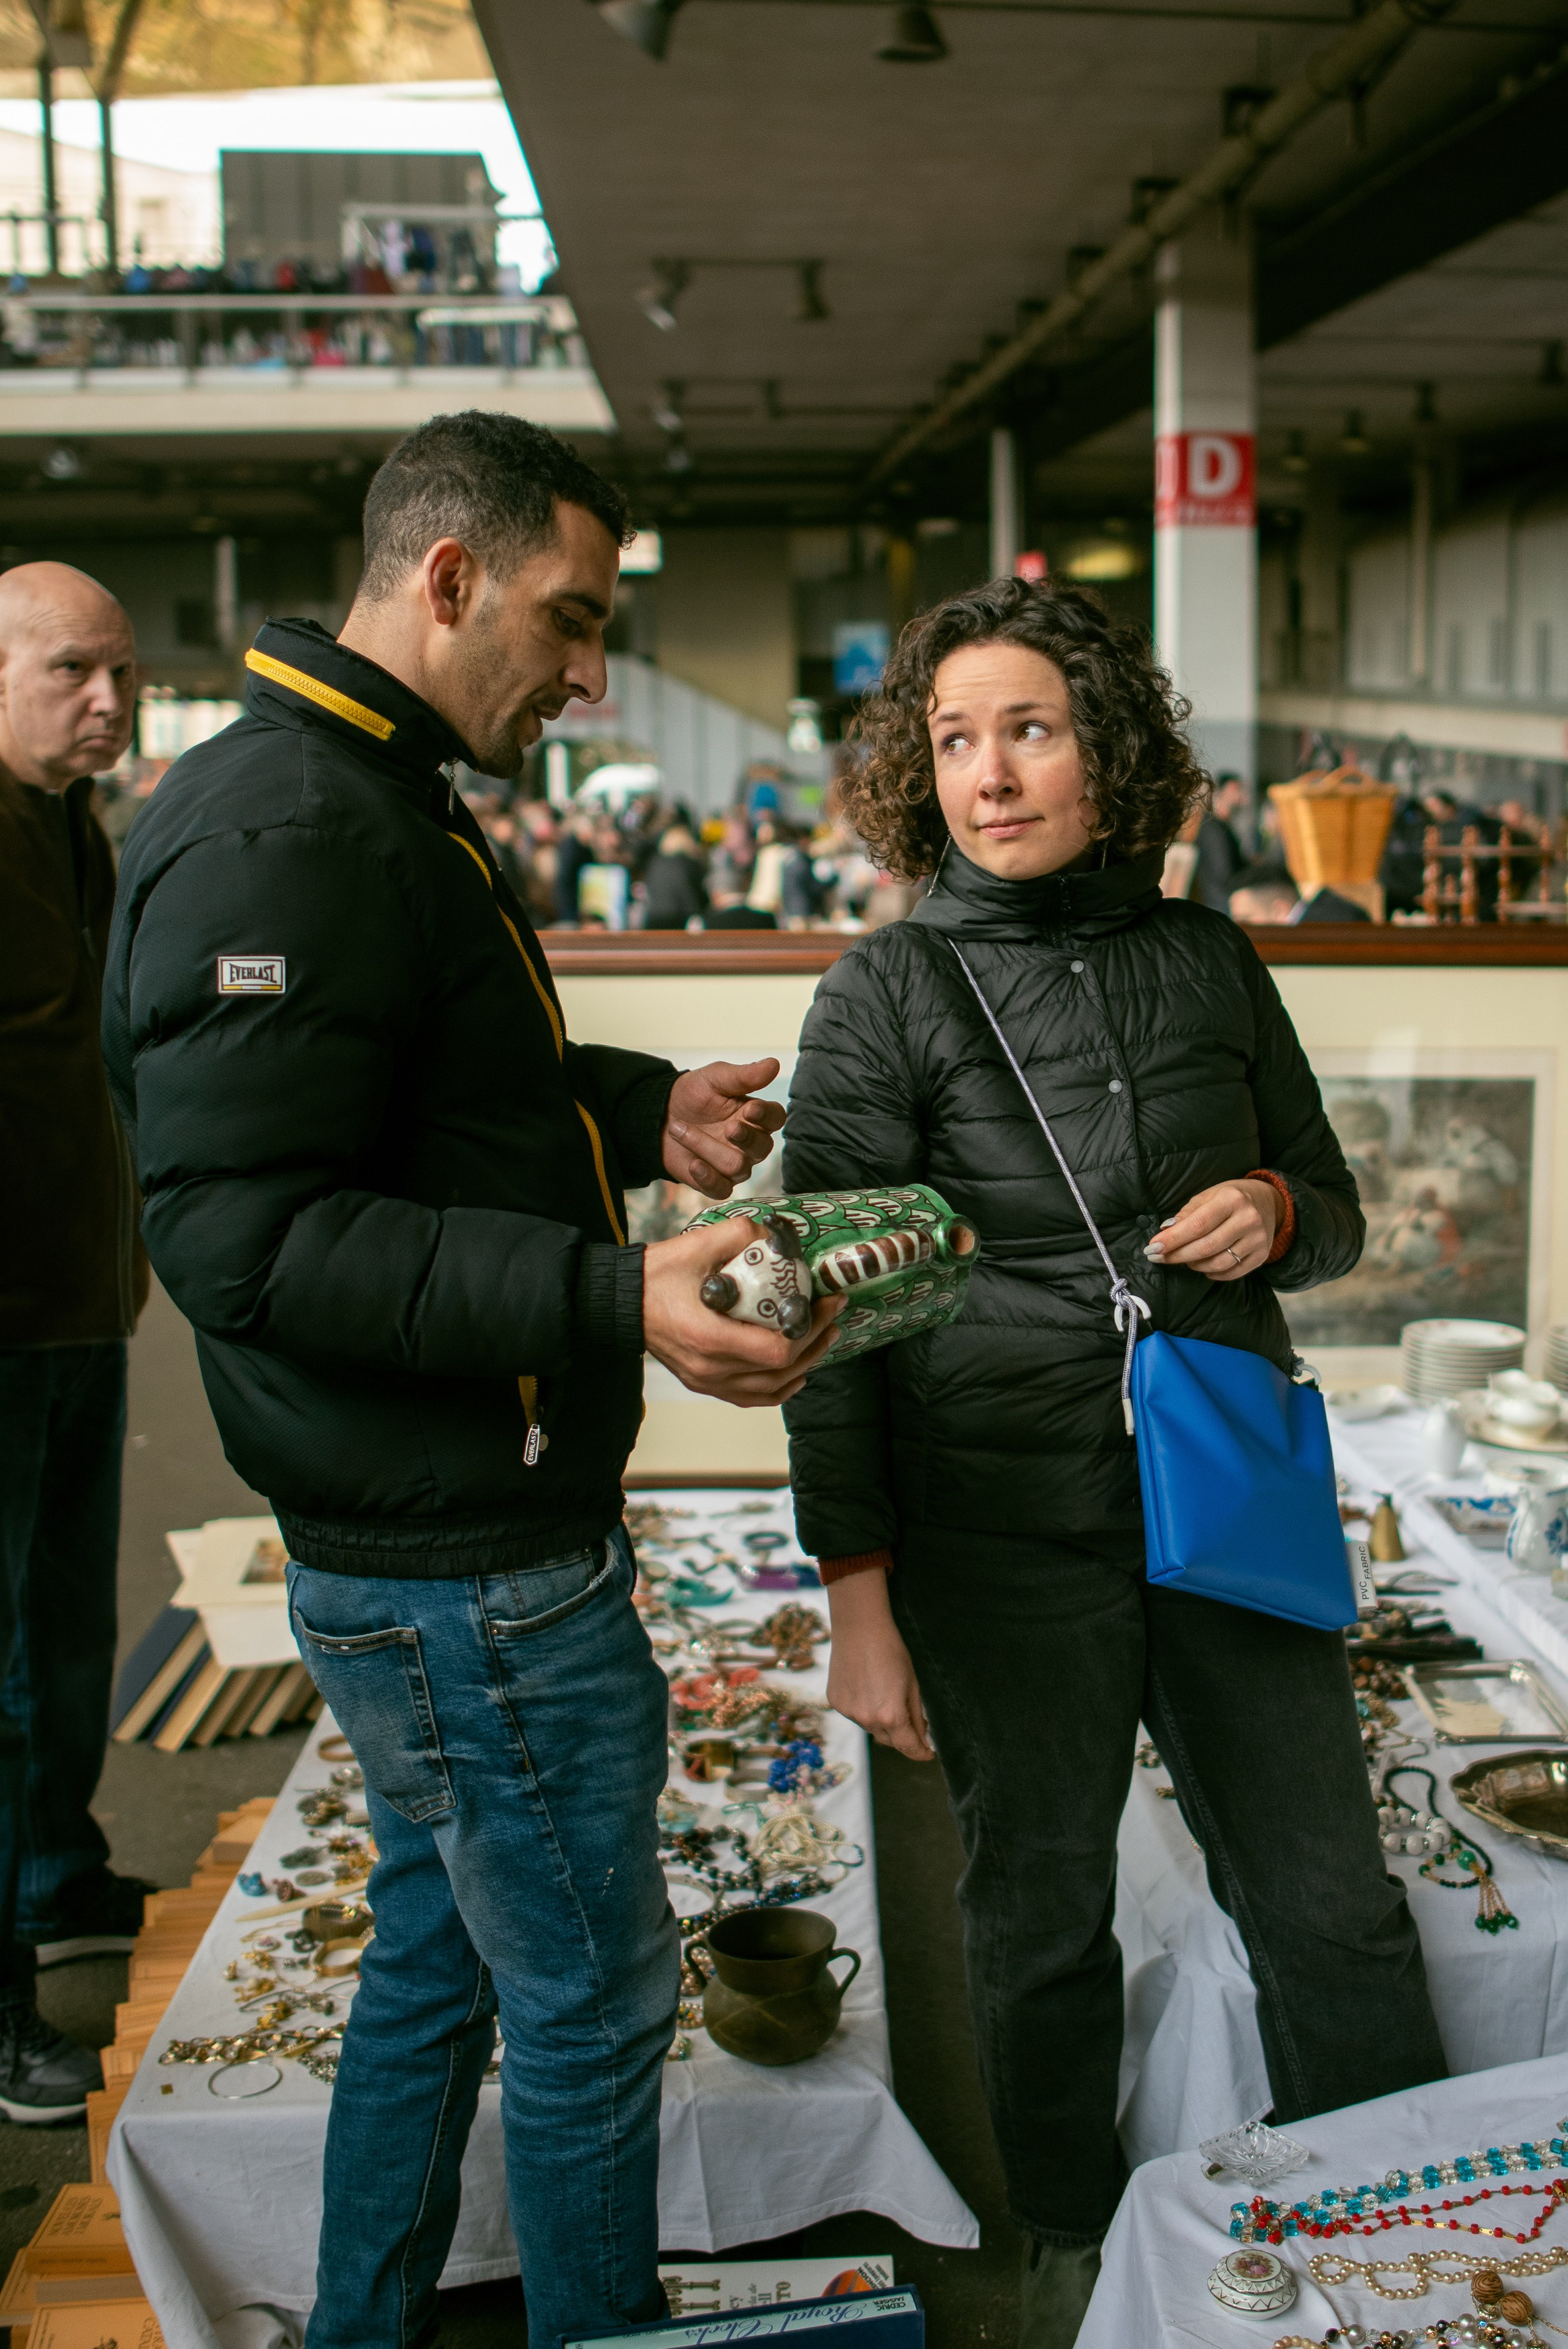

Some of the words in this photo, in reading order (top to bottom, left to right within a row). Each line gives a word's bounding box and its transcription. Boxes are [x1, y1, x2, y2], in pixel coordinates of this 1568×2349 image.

[1187, 437, 1242, 497] D
[229, 963, 277, 984] EVERLAST
[528, 1431, 538, 1460] EVERLAST
[1359, 1546, 1371, 1579] FABRIC
[1359, 1581, 1370, 1600] PVC
[873, 2296, 905, 2305] JAGGER
[876, 2302, 906, 2311] CEDRIC
[780, 2303, 867, 2332] Royal
[685, 2318, 773, 2345] Clocks
